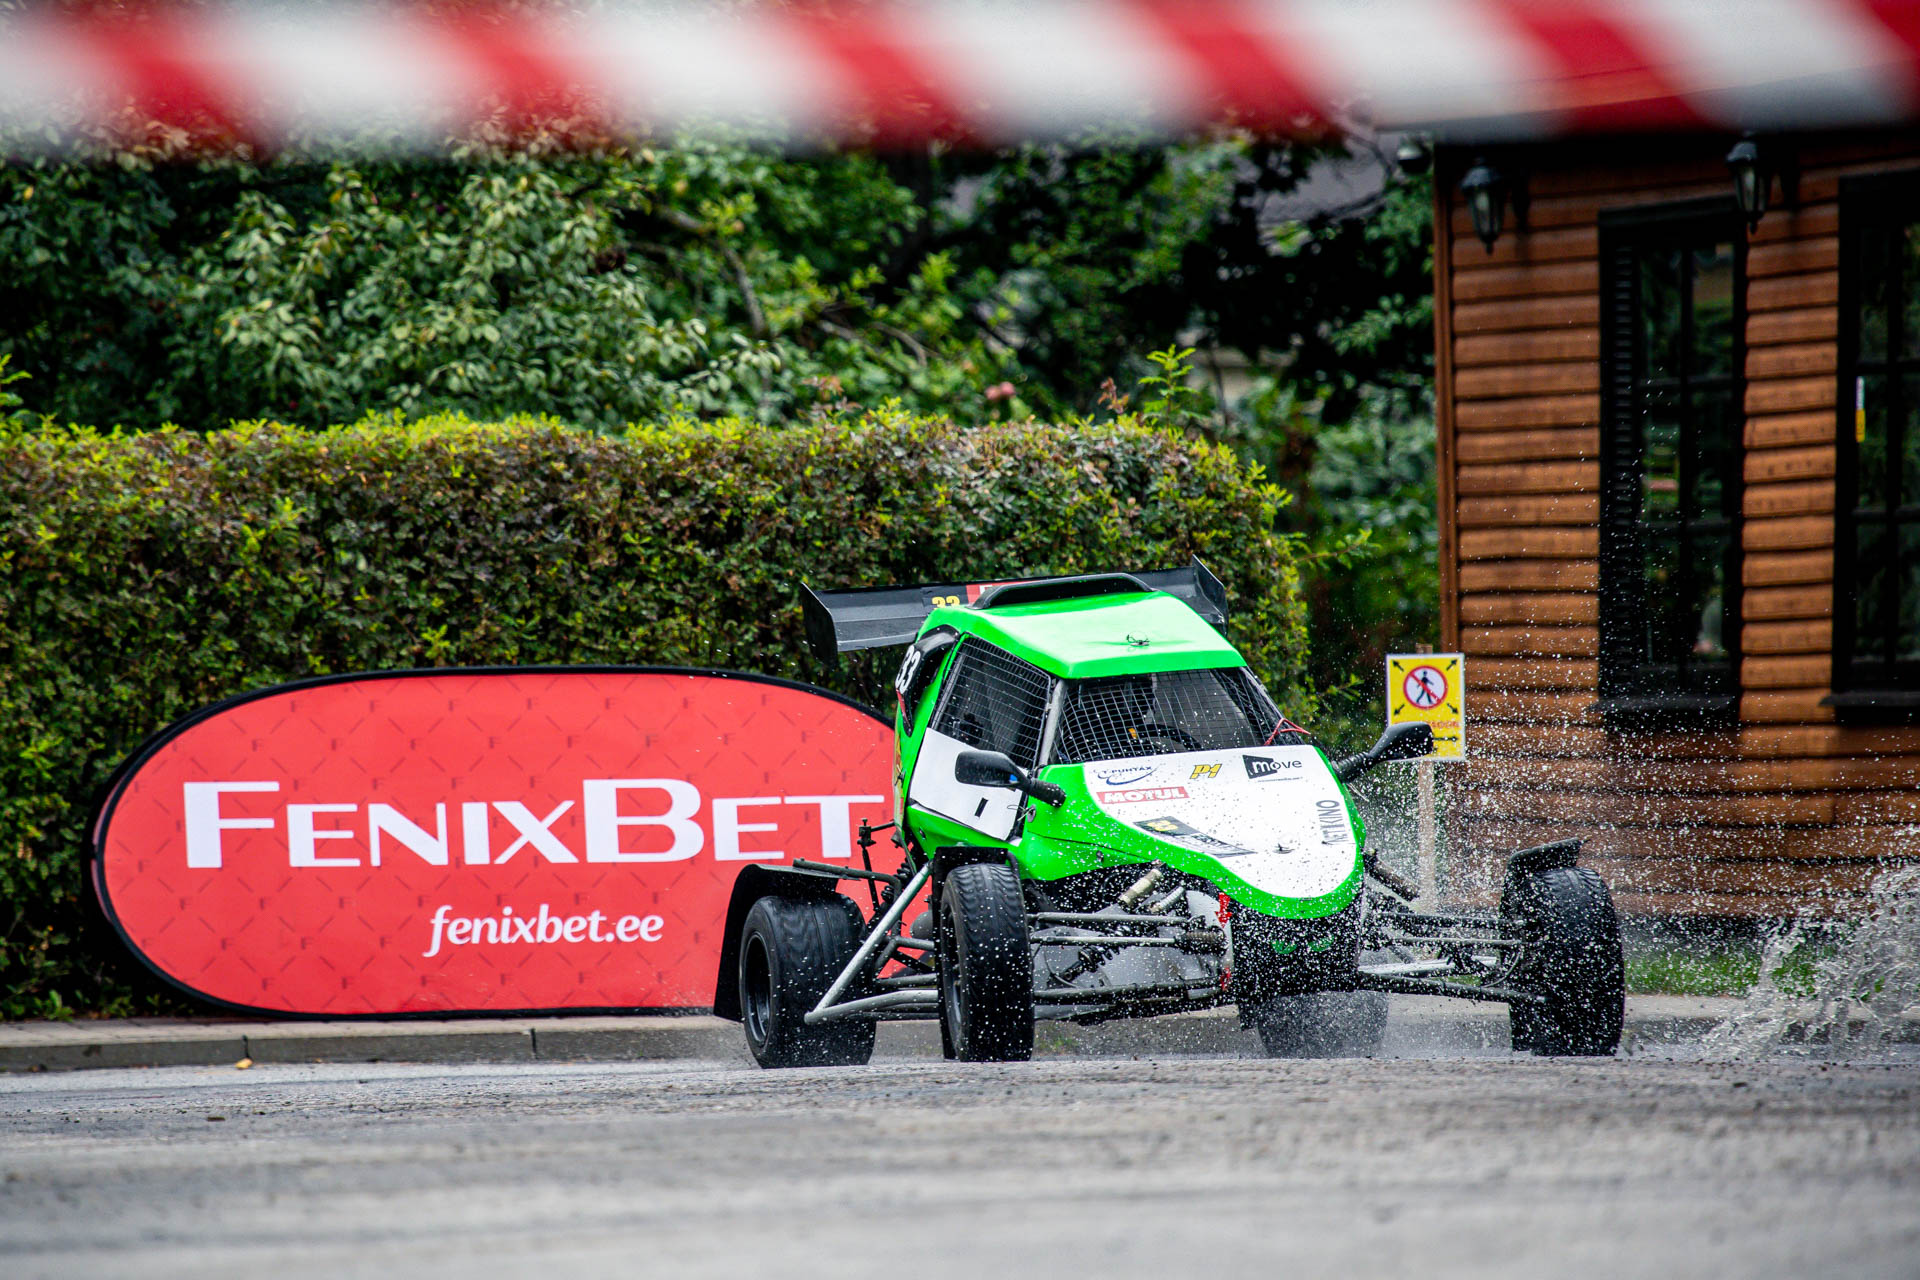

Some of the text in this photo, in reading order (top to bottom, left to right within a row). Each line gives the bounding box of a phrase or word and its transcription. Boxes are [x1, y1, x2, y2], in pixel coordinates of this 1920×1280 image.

[895, 644, 921, 694] 33
[1252, 760, 1302, 773] move
[1103, 788, 1185, 804] MOTUL
[424, 904, 664, 957] fenixbet.ee
